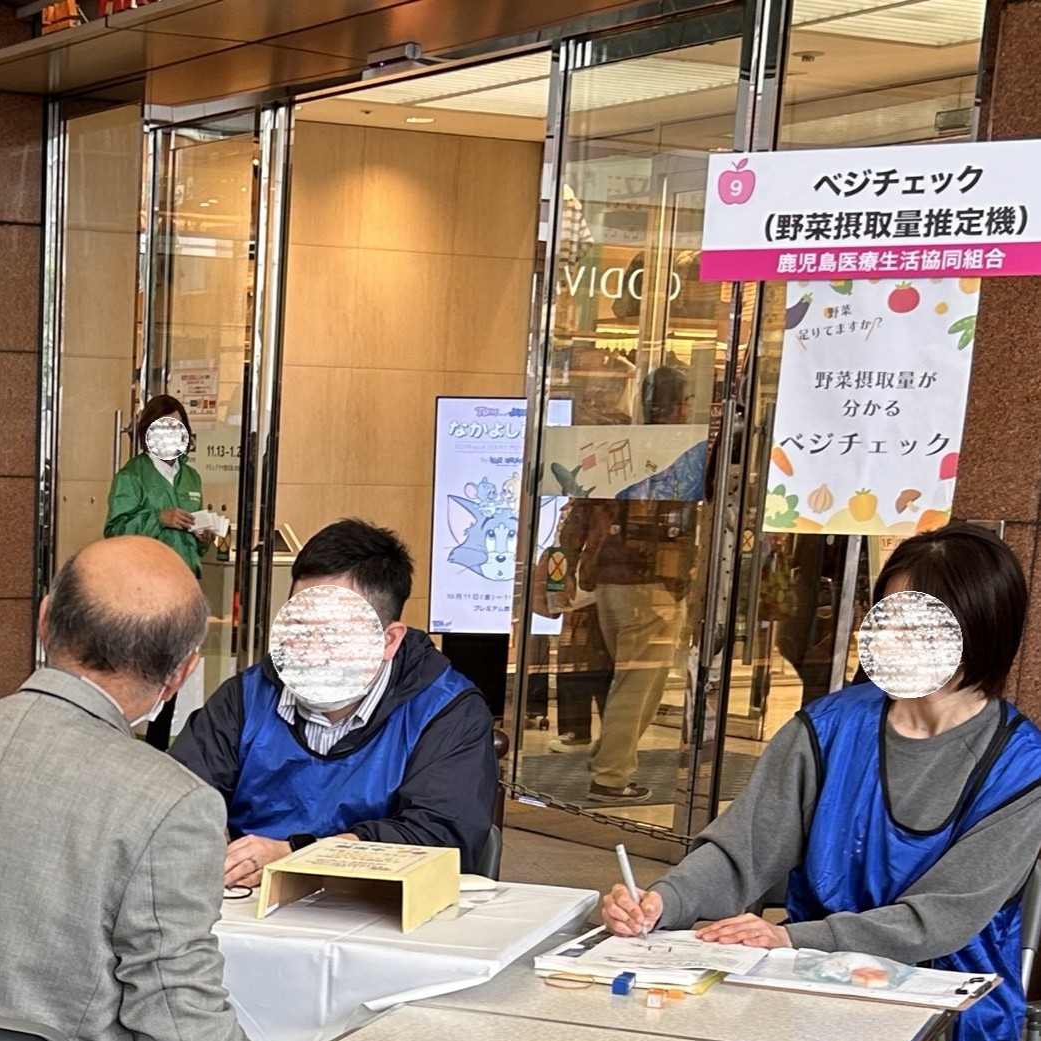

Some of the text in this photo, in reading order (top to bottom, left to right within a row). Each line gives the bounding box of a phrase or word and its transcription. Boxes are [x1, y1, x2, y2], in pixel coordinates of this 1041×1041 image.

[730, 179, 742, 196] 9
[813, 165, 985, 197] ベジチェック
[764, 205, 1030, 243] (野菜摂取量推定機)
[776, 248, 1007, 275] 鹿児島医療生活協同組合
[824, 304, 852, 319] 野菜
[814, 370, 937, 390] 野菜摂取量が
[842, 400, 901, 418] 分かる
[448, 419, 526, 439] なかよし
[780, 432, 952, 457] ベジチェック
